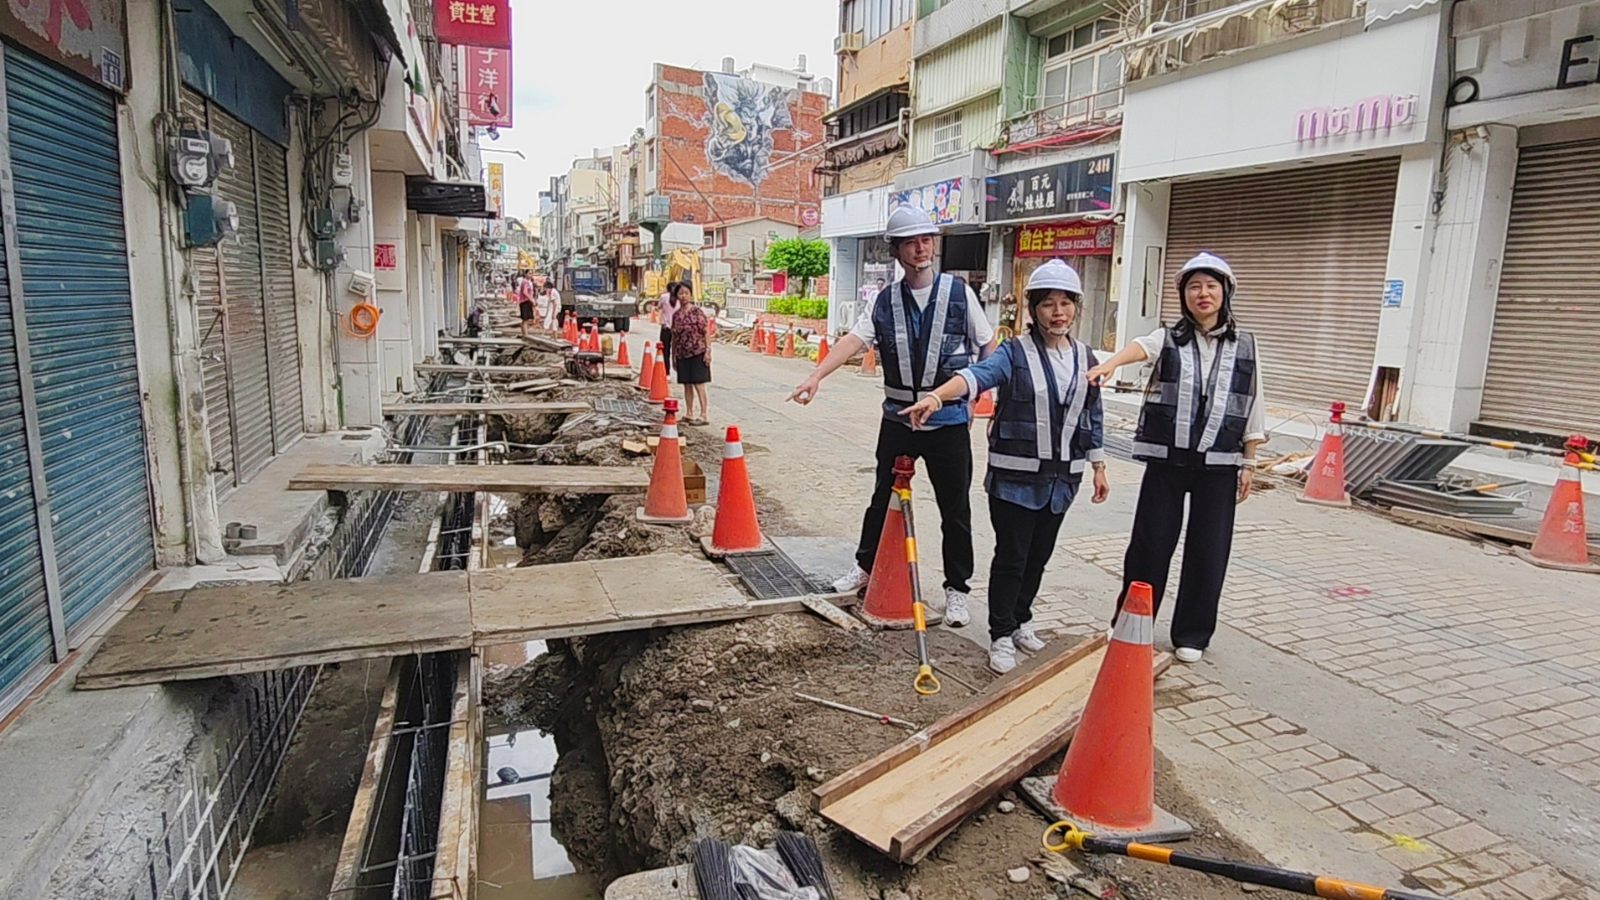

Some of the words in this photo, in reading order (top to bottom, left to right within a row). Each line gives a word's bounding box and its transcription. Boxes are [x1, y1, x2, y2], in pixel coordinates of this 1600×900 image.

[448, 1, 496, 25] 資生堂
[1557, 35, 1600, 89] E
[109, 65, 119, 85] 61
[1088, 158, 1110, 174] 24H
[1031, 173, 1051, 191] 百元
[1024, 191, 1055, 210] 娃娃屋
